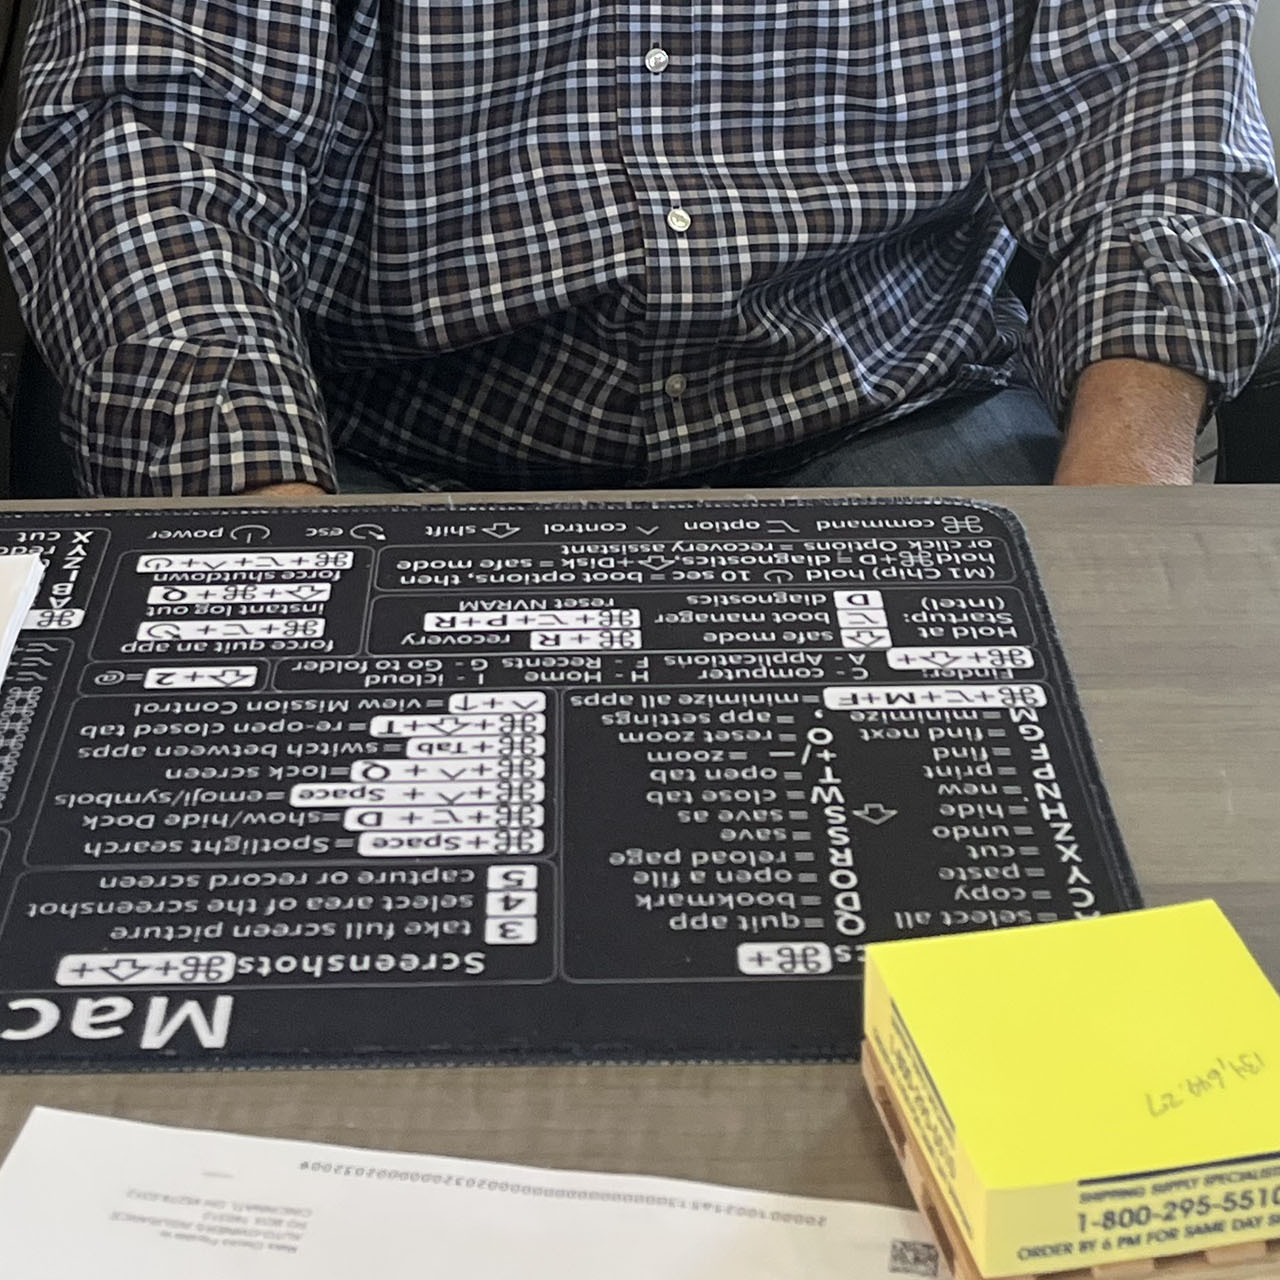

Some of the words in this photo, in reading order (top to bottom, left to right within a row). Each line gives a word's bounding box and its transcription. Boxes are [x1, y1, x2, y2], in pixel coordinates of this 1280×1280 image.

[426, 526, 475, 536] shift
[544, 523, 626, 534] control
[685, 519, 760, 532] option
[817, 519, 934, 531] command
[17, 532, 60, 542] cut
[148, 527, 223, 538] power
[306, 528, 343, 536] esc
[154, 572, 275, 583] shutdown
[282, 571, 340, 581] force
[147, 606, 188, 616] out
[195, 603, 231, 615] log
[239, 604, 323, 615] instant
[460, 600, 546, 611] NVRAM
[555, 598, 615, 611] reset
[655, 611, 765, 623] manager
[772, 612, 829, 624] boot
[904, 611, 1013, 624] Startup:
[401, 633, 510, 645] recovery
[703, 631, 761, 645] mode
[766, 630, 833, 645] safe
[917, 626, 947, 642] at
[952, 627, 1017, 639] Hold
[120, 640, 170, 654] app
[177, 642, 208, 651] an
[215, 640, 265, 653] quit
[271, 640, 333, 652] force
[502, 657, 601, 669] Recents
[663, 652, 823, 668] Applications
[292, 661, 367, 673] folder
[697, 667, 824, 680] computer
[525, 671, 601, 683] Home
[571, 693, 633, 706] apps
[641, 695, 671, 708] all
[134, 702, 237, 716] Control
[247, 700, 349, 714] Mission
[81, 725, 124, 738] tab
[134, 723, 224, 738] closed
[619, 731, 694, 742] zoom
[860, 728, 919, 741] next
[79, 744, 146, 757] apps
[155, 744, 277, 758] between
[166, 767, 259, 779] screen
[650, 769, 696, 784] tab
[646, 791, 693, 805] tab
[702, 789, 776, 804] close
[83, 815, 155, 830] Dock
[678, 811, 709, 822] as
[84, 840, 183, 857] search
[609, 848, 681, 865] page
[692, 851, 786, 867] reload
[100, 875, 200, 888] screen
[209, 873, 307, 890] record
[317, 871, 348, 884] or
[358, 867, 474, 885] capture
[633, 871, 680, 888] file
[690, 871, 705, 883] a
[28, 900, 198, 918] screenshot
[207, 899, 256, 916] the
[264, 898, 297, 915] of
[307, 896, 373, 910] area
[383, 895, 473, 912] select
[670, 912, 727, 929] app
[895, 912, 931, 928] all
[110, 922, 223, 942] picture
[233, 923, 335, 937] screen
[346, 923, 394, 940] full
[405, 920, 471, 938] take
[500, 922, 523, 939] 3
[238, 953, 485, 977] Screenshots
[0, 996, 233, 1049] Mac
[1080, 1187, 1145, 1204] SHIPPING
[1151, 1178, 1199, 1194] SUPPLY
[1017, 1242, 1073, 1260] ORDER
[1079, 1240, 1096, 1253] BY
[1102, 1238, 1112, 1250] 6
[1117, 1234, 1141, 1247] PM
[1146, 1228, 1180, 1244] FOR
[1185, 1220, 1226, 1237] SAME
[1231, 1216, 1263, 1231] DAY
